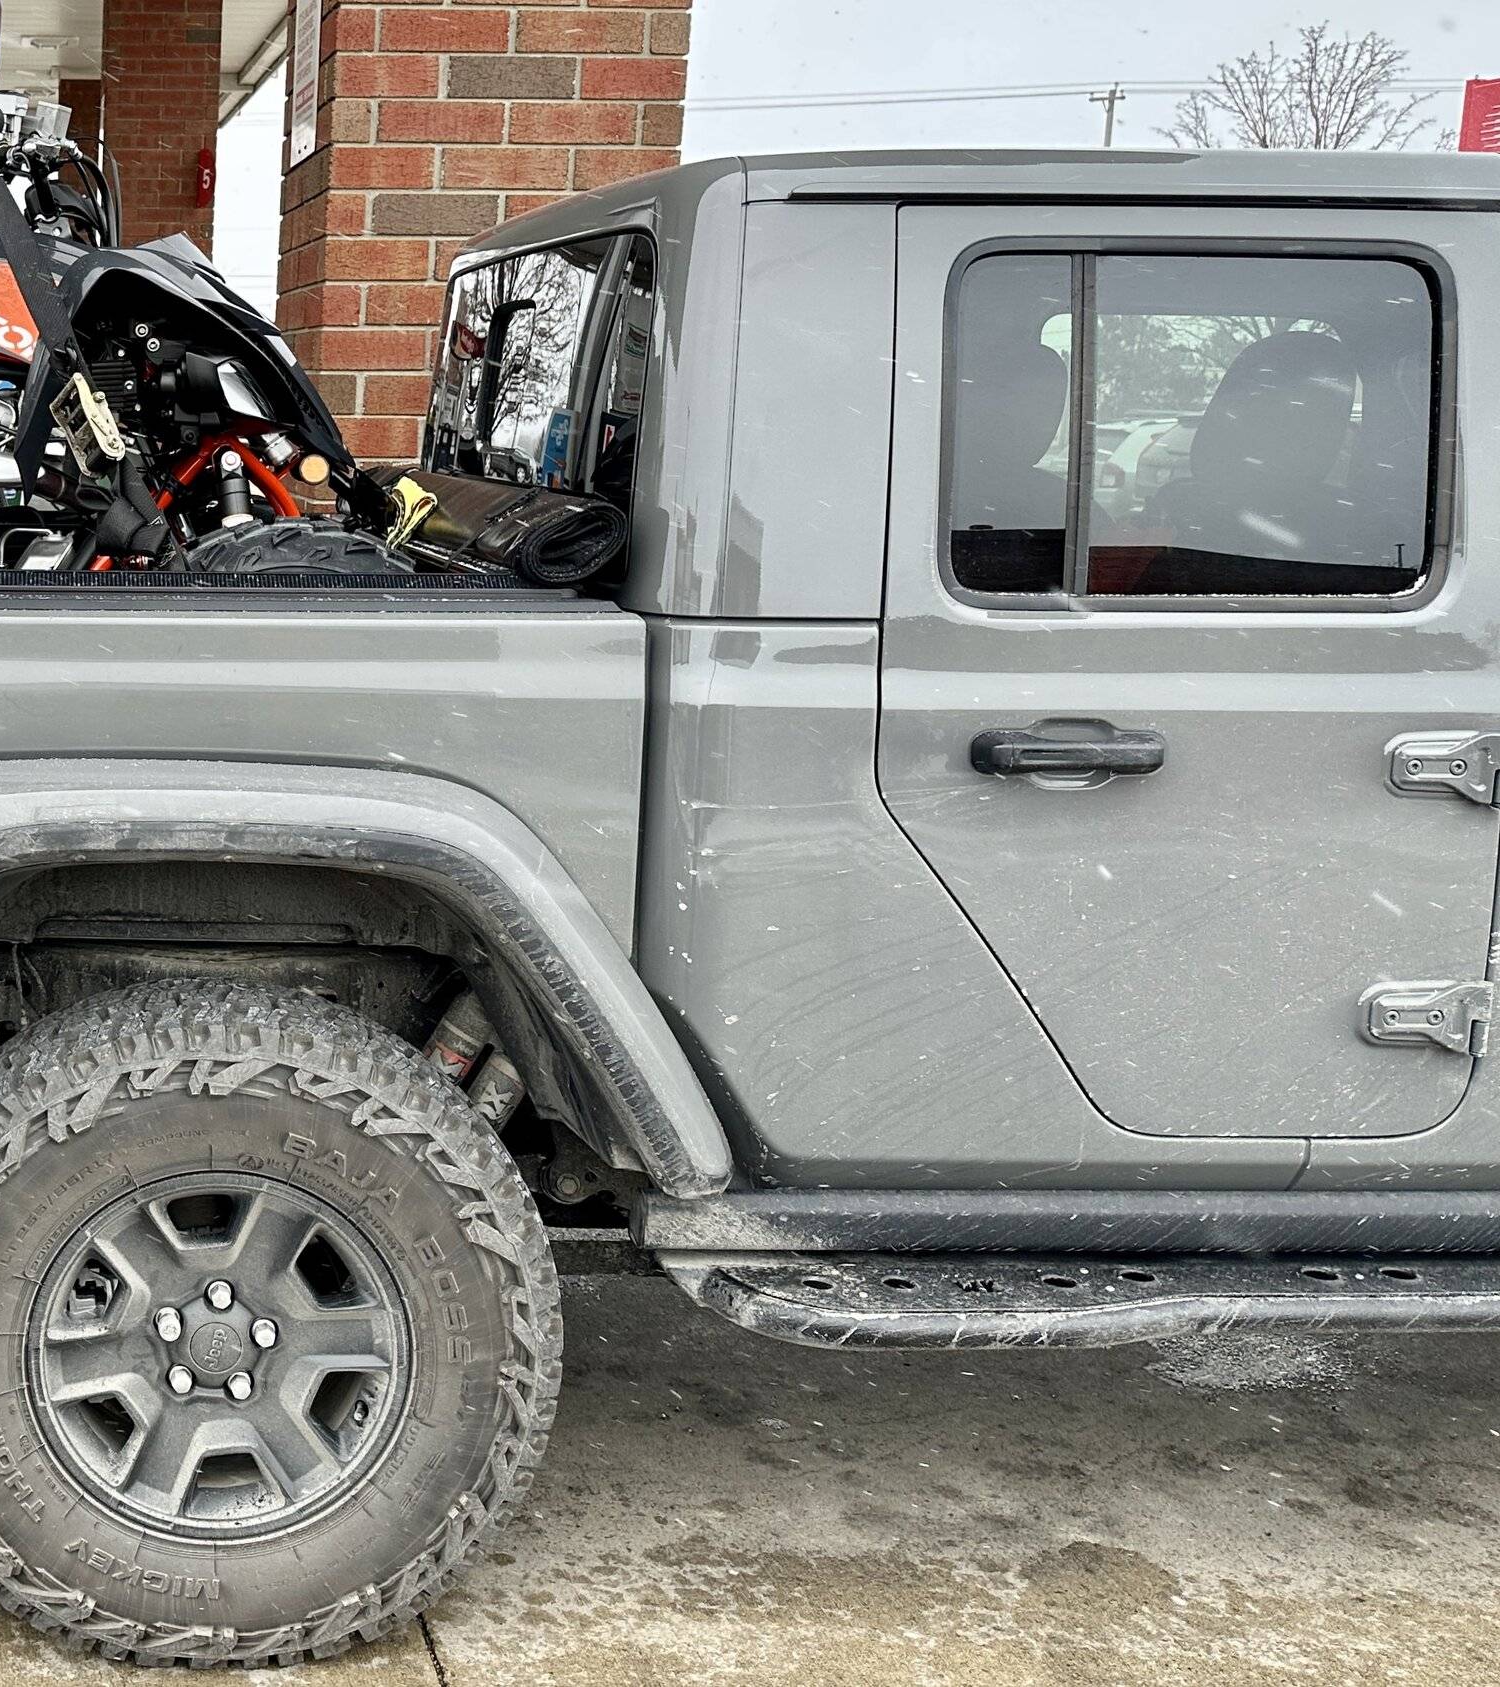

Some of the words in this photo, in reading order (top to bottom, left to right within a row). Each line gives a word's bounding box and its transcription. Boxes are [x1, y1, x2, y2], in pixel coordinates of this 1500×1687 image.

[202, 169, 211, 190] 5
[283, 1131, 400, 1216] BAJA
[412, 1235, 475, 1366] BOSS
[204, 1328, 228, 1370] Jeep
[63, 1537, 222, 1600] MICKEY
